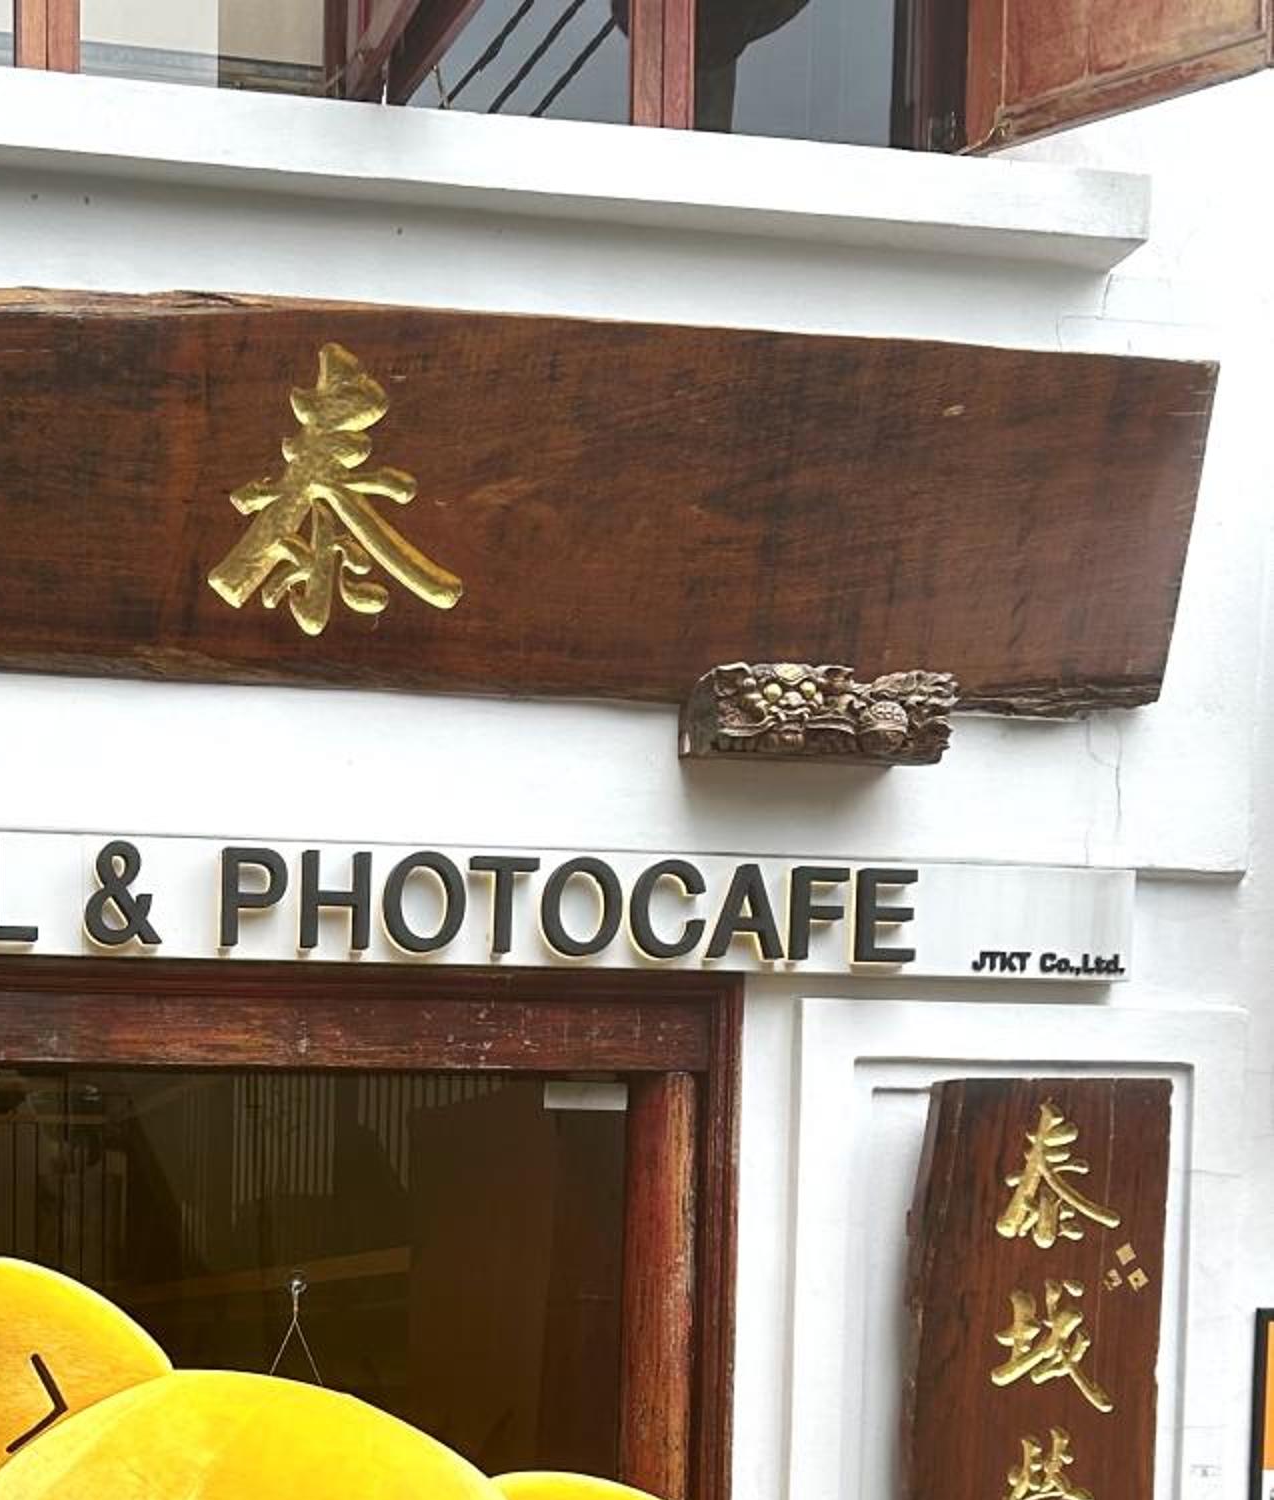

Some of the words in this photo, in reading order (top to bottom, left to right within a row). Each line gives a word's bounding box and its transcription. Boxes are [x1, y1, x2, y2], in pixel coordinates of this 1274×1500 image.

[82, 839, 163, 953] &
[219, 847, 918, 972] PHOTOCAFE
[972, 951, 1032, 973] JTKT
